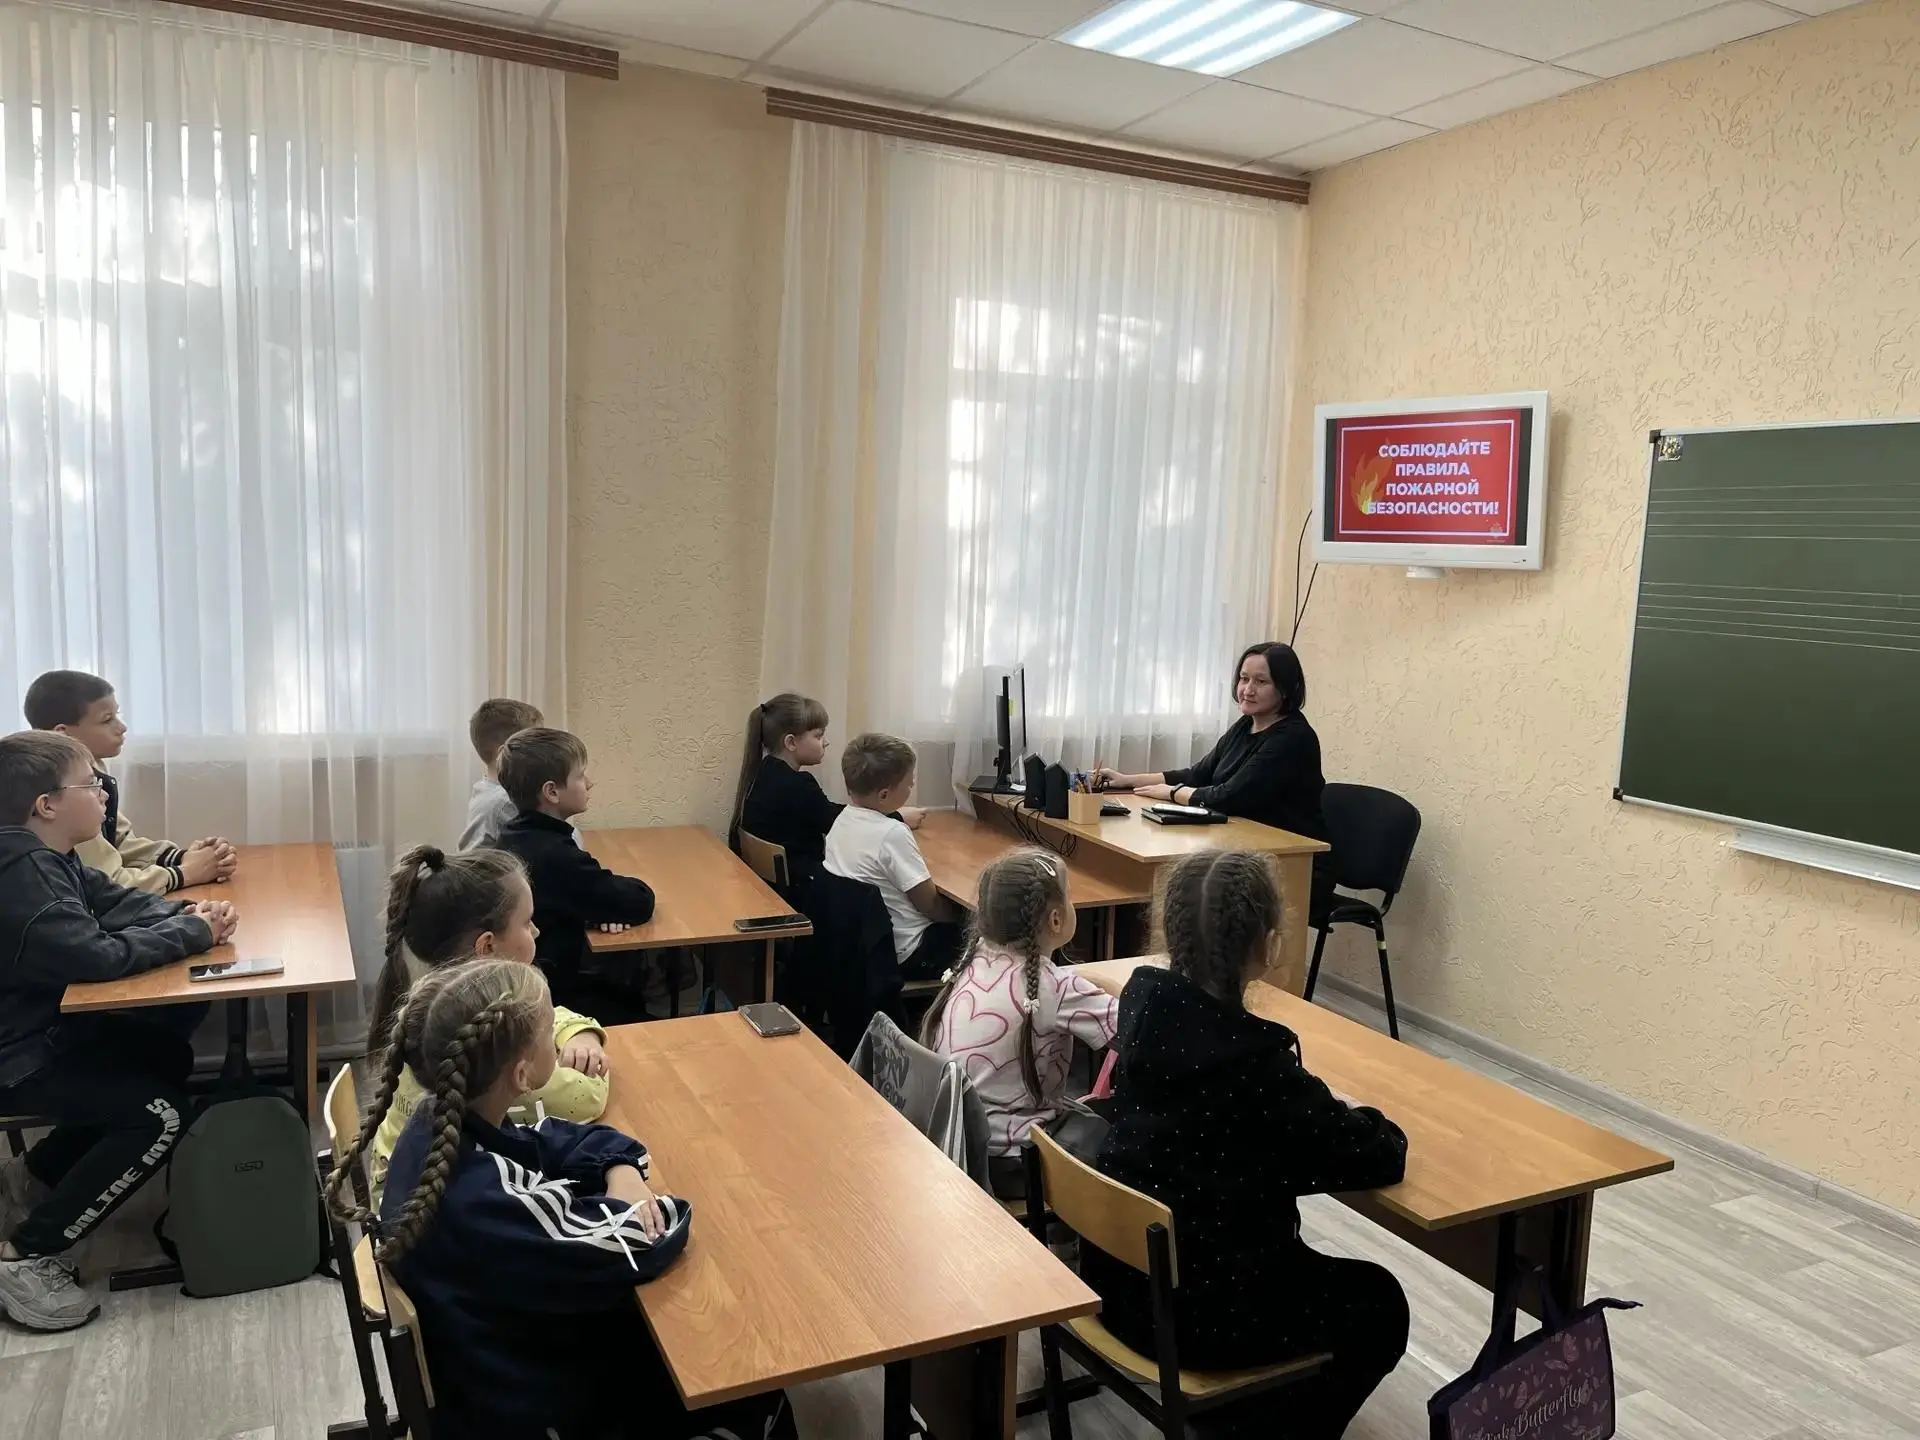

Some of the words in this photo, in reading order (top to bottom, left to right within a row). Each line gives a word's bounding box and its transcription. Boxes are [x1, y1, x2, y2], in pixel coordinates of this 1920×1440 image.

[1379, 439, 1491, 459] СОБЛЮДАЙТЕ
[1396, 462, 1470, 477] ПРАВИЛА
[1386, 479, 1479, 496] ПОЖАРНОЙ
[1367, 501, 1499, 516] БЕЗОПАСНОСТИ!
[63, 1166, 143, 1240] ONLINE
[1514, 1384, 1584, 1436] Butterfly
